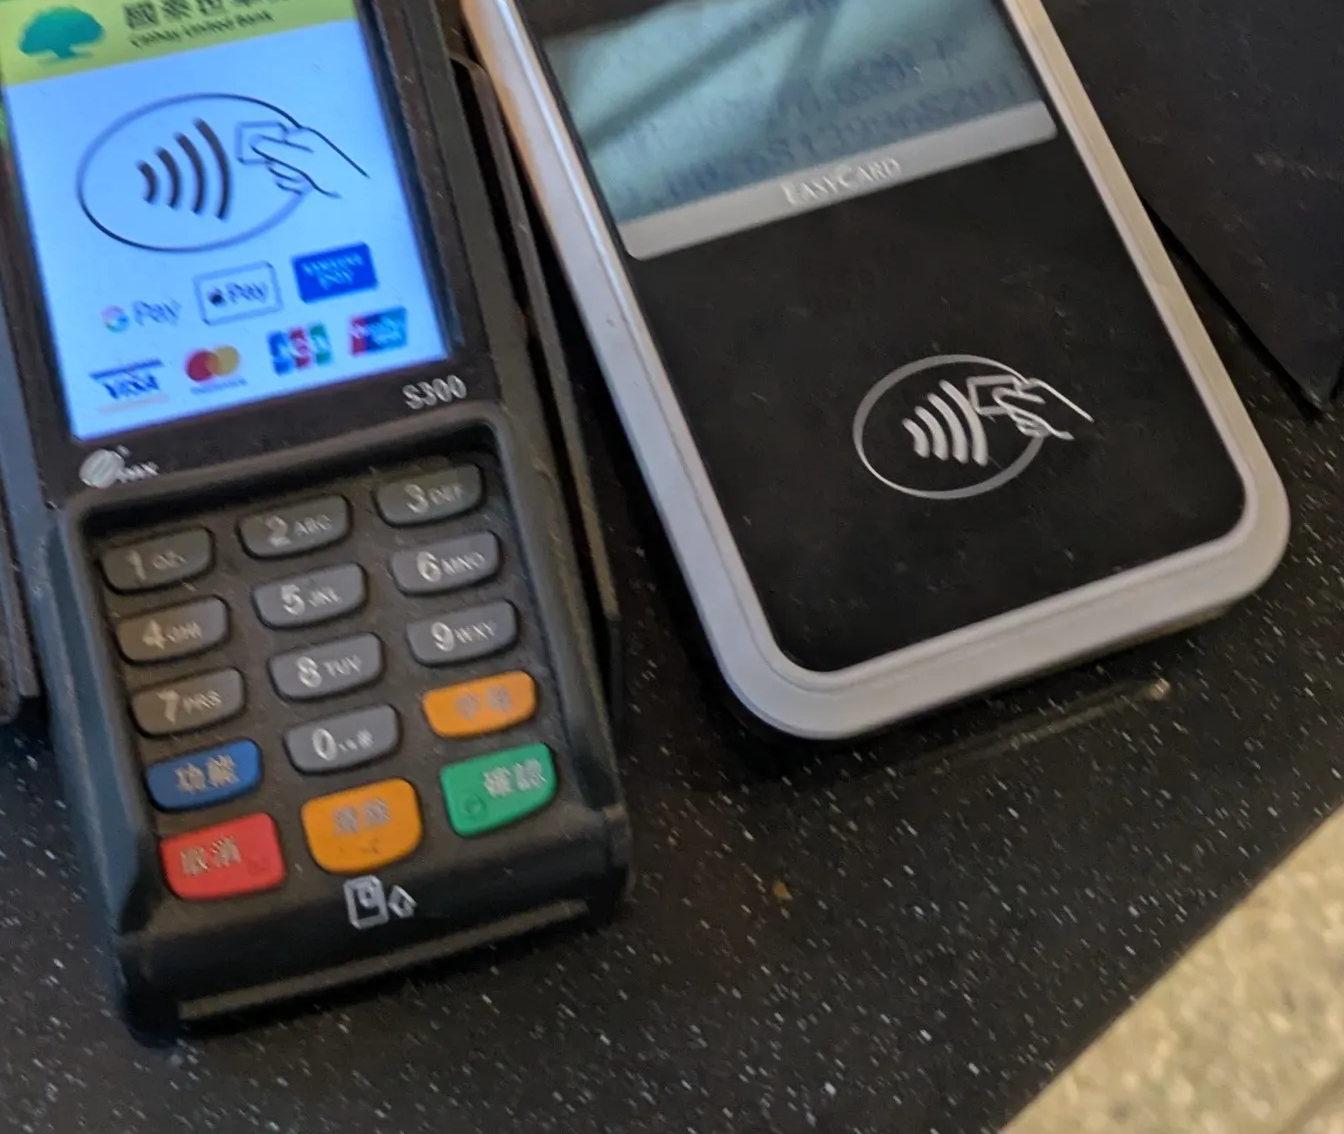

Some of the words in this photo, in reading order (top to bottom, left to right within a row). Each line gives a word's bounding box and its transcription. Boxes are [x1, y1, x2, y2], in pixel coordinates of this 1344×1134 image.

[225, 279, 269, 305] Pay
[131, 297, 182, 327] Pay
[402, 376, 468, 411] S300
[406, 481, 429, 515] 3
[264, 515, 289, 547] 2
[129, 548, 146, 579] 1
[415, 549, 441, 582] 6
[279, 584, 305, 617] 5
[142, 620, 164, 652] 4
[430, 619, 456, 652] 9
[297, 655, 322, 689] 8
[157, 690, 183, 724] 7
[312, 727, 337, 762] 0
